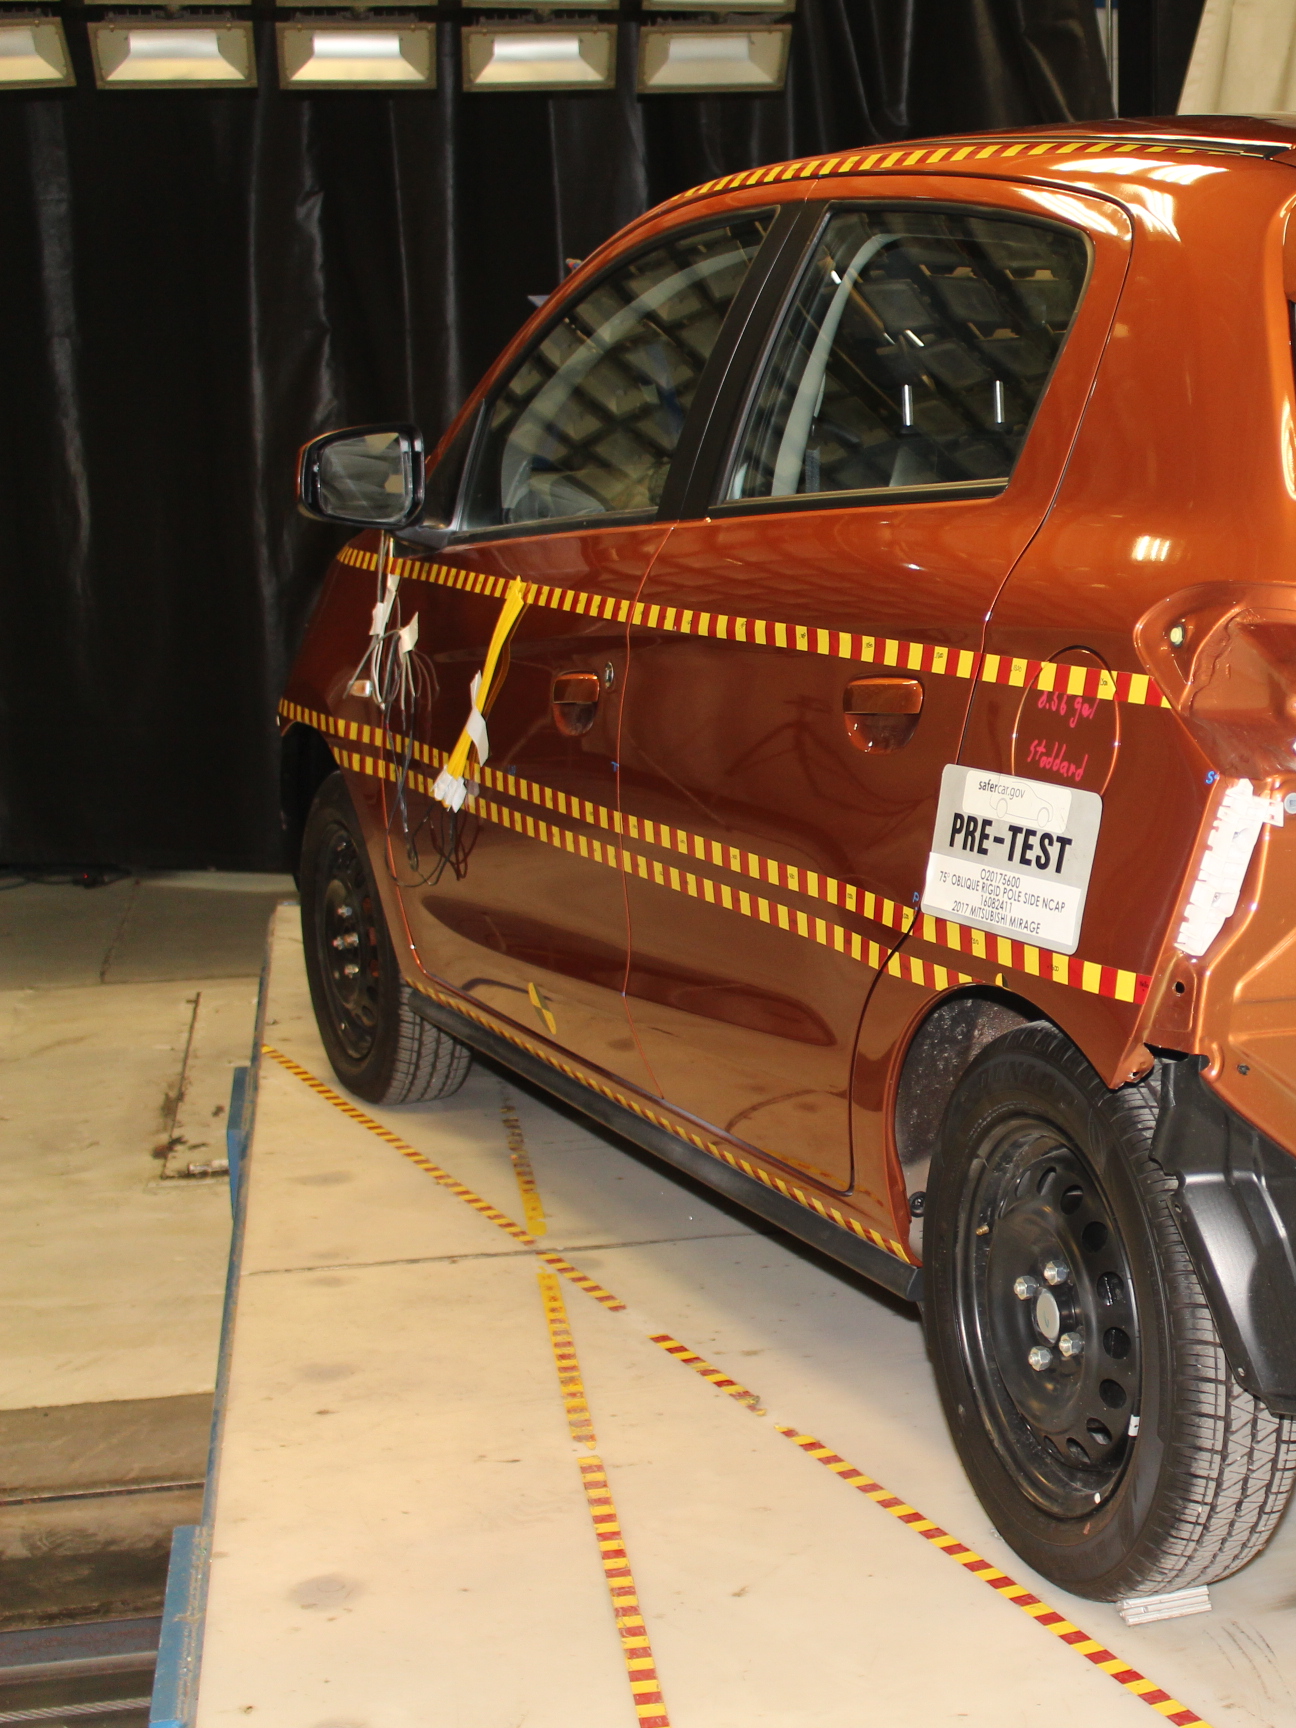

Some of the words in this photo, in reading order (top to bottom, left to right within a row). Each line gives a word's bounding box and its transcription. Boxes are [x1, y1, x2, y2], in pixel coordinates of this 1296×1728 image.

[978, 778, 1026, 800] safercar.gov
[949, 811, 1073, 875] PRE-TEST
[951, 874, 980, 892] OBLIQUE
[981, 881, 1001, 897] RIGID
[1002, 887, 1022, 903] POLE
[1023, 892, 1041, 907] SIDE
[1042, 896, 1066, 914] NCAP
[980, 894, 1013, 913] 16082411
[952, 900, 969, 913] 2017
[969, 904, 1008, 925] MITSUBISHI
[1009, 918, 1041, 934] MIRAGE
